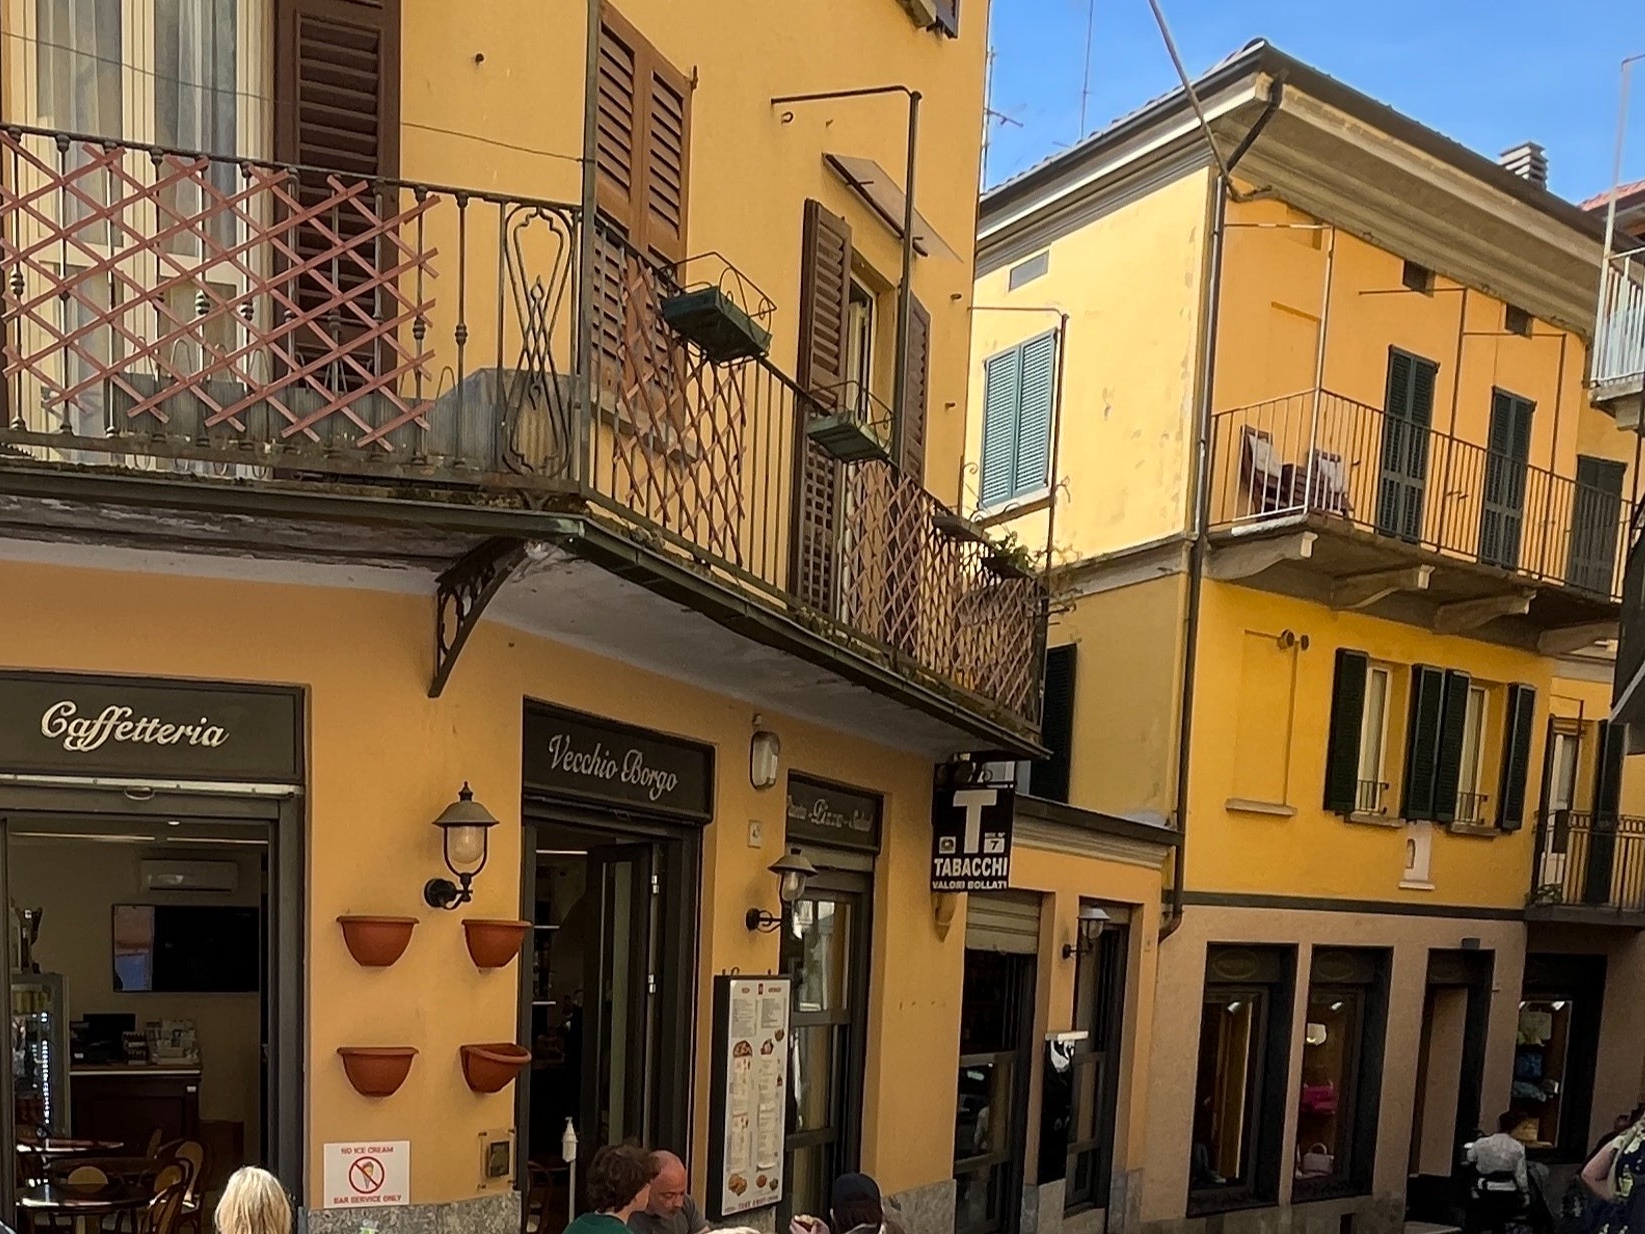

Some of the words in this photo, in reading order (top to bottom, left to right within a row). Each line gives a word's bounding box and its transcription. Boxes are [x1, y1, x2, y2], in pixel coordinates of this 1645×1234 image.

[41, 700, 229, 751] Caffetteria
[549, 734, 618, 780] Vecchio
[621, 749, 679, 801] Borgo
[952, 789, 998, 854] T
[990, 840, 999, 850] 7
[934, 857, 1008, 877] TABACCHI
[932, 881, 966, 889] VALORI
[967, 880, 1008, 890] BOLLATI
[333, 1196, 350, 1204] BAR
[351, 1195, 381, 1203] SERVICE
[383, 1194, 402, 1202] ONLY
